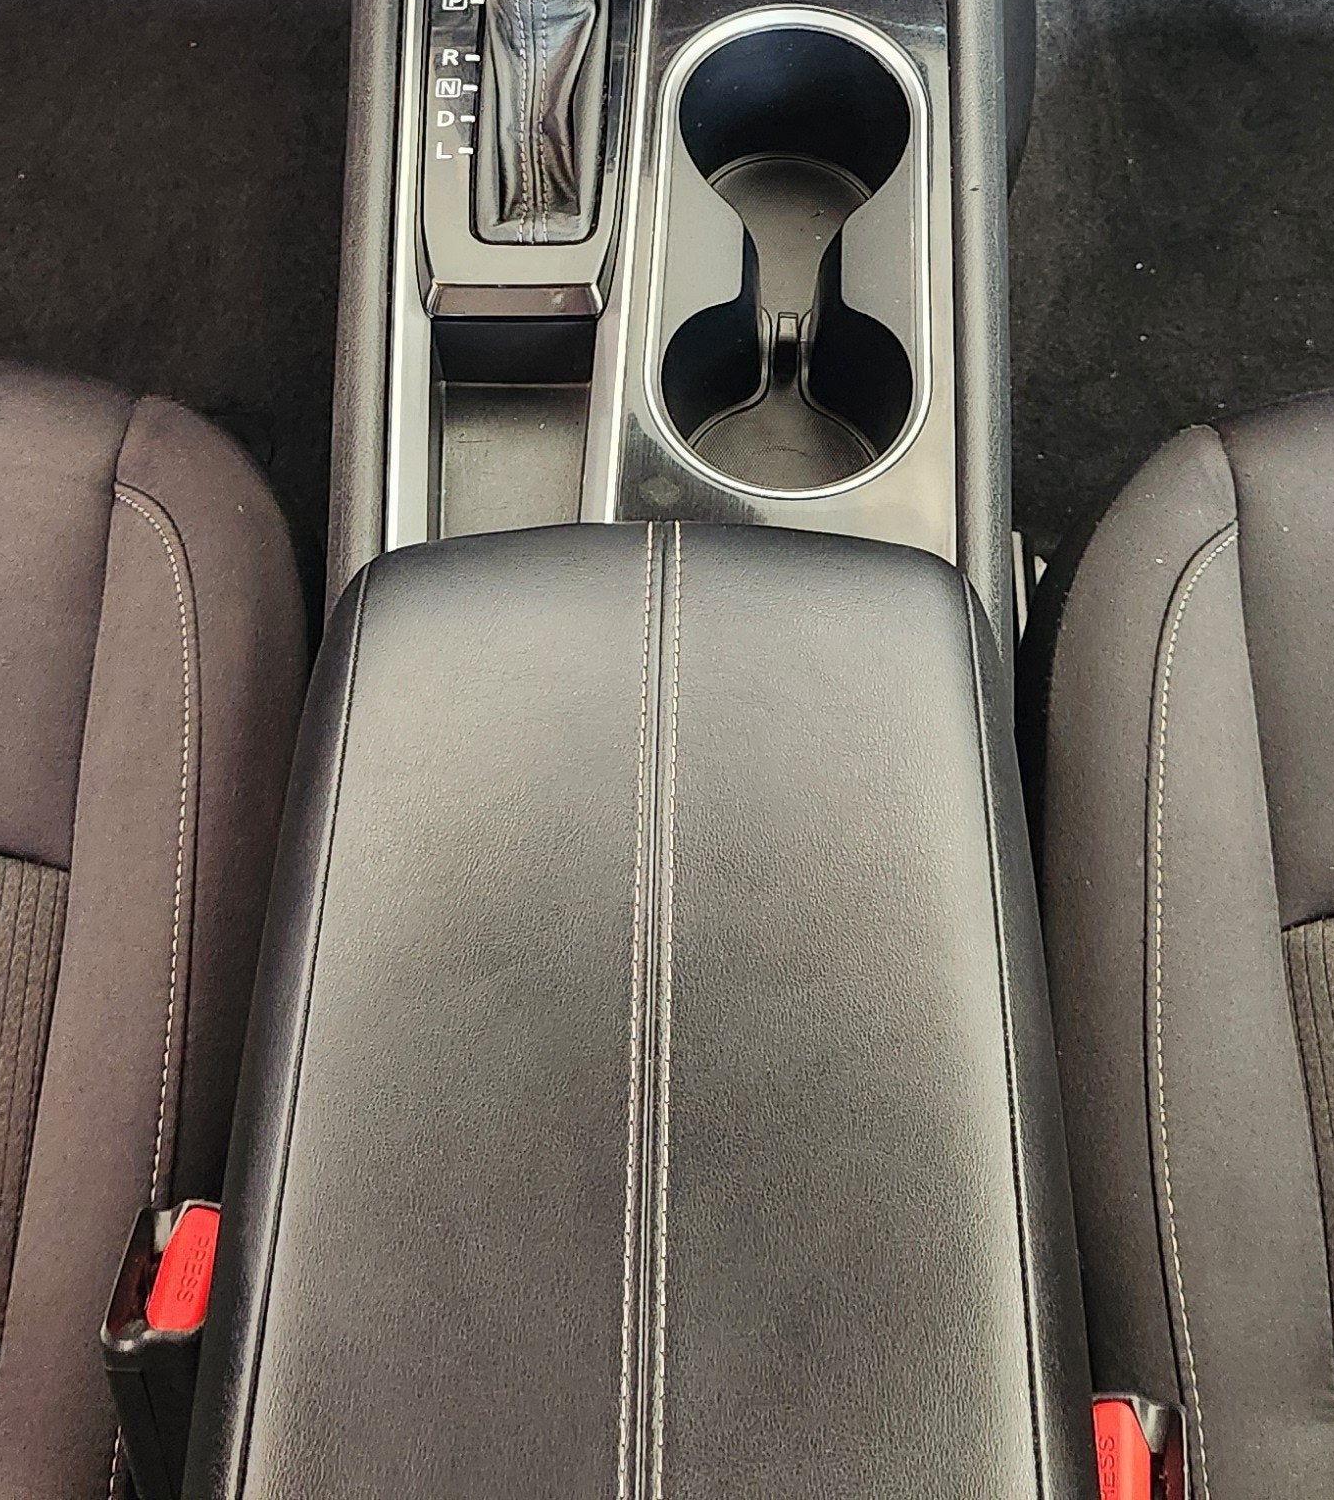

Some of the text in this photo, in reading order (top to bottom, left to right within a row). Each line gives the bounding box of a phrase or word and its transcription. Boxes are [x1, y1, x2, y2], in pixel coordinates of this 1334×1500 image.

[442, 49, 459, 66] R
[440, 81, 456, 95] N
[436, 110, 455, 127] D
[435, 141, 453, 160] L
[176, 1236, 210, 1302] PRESS
